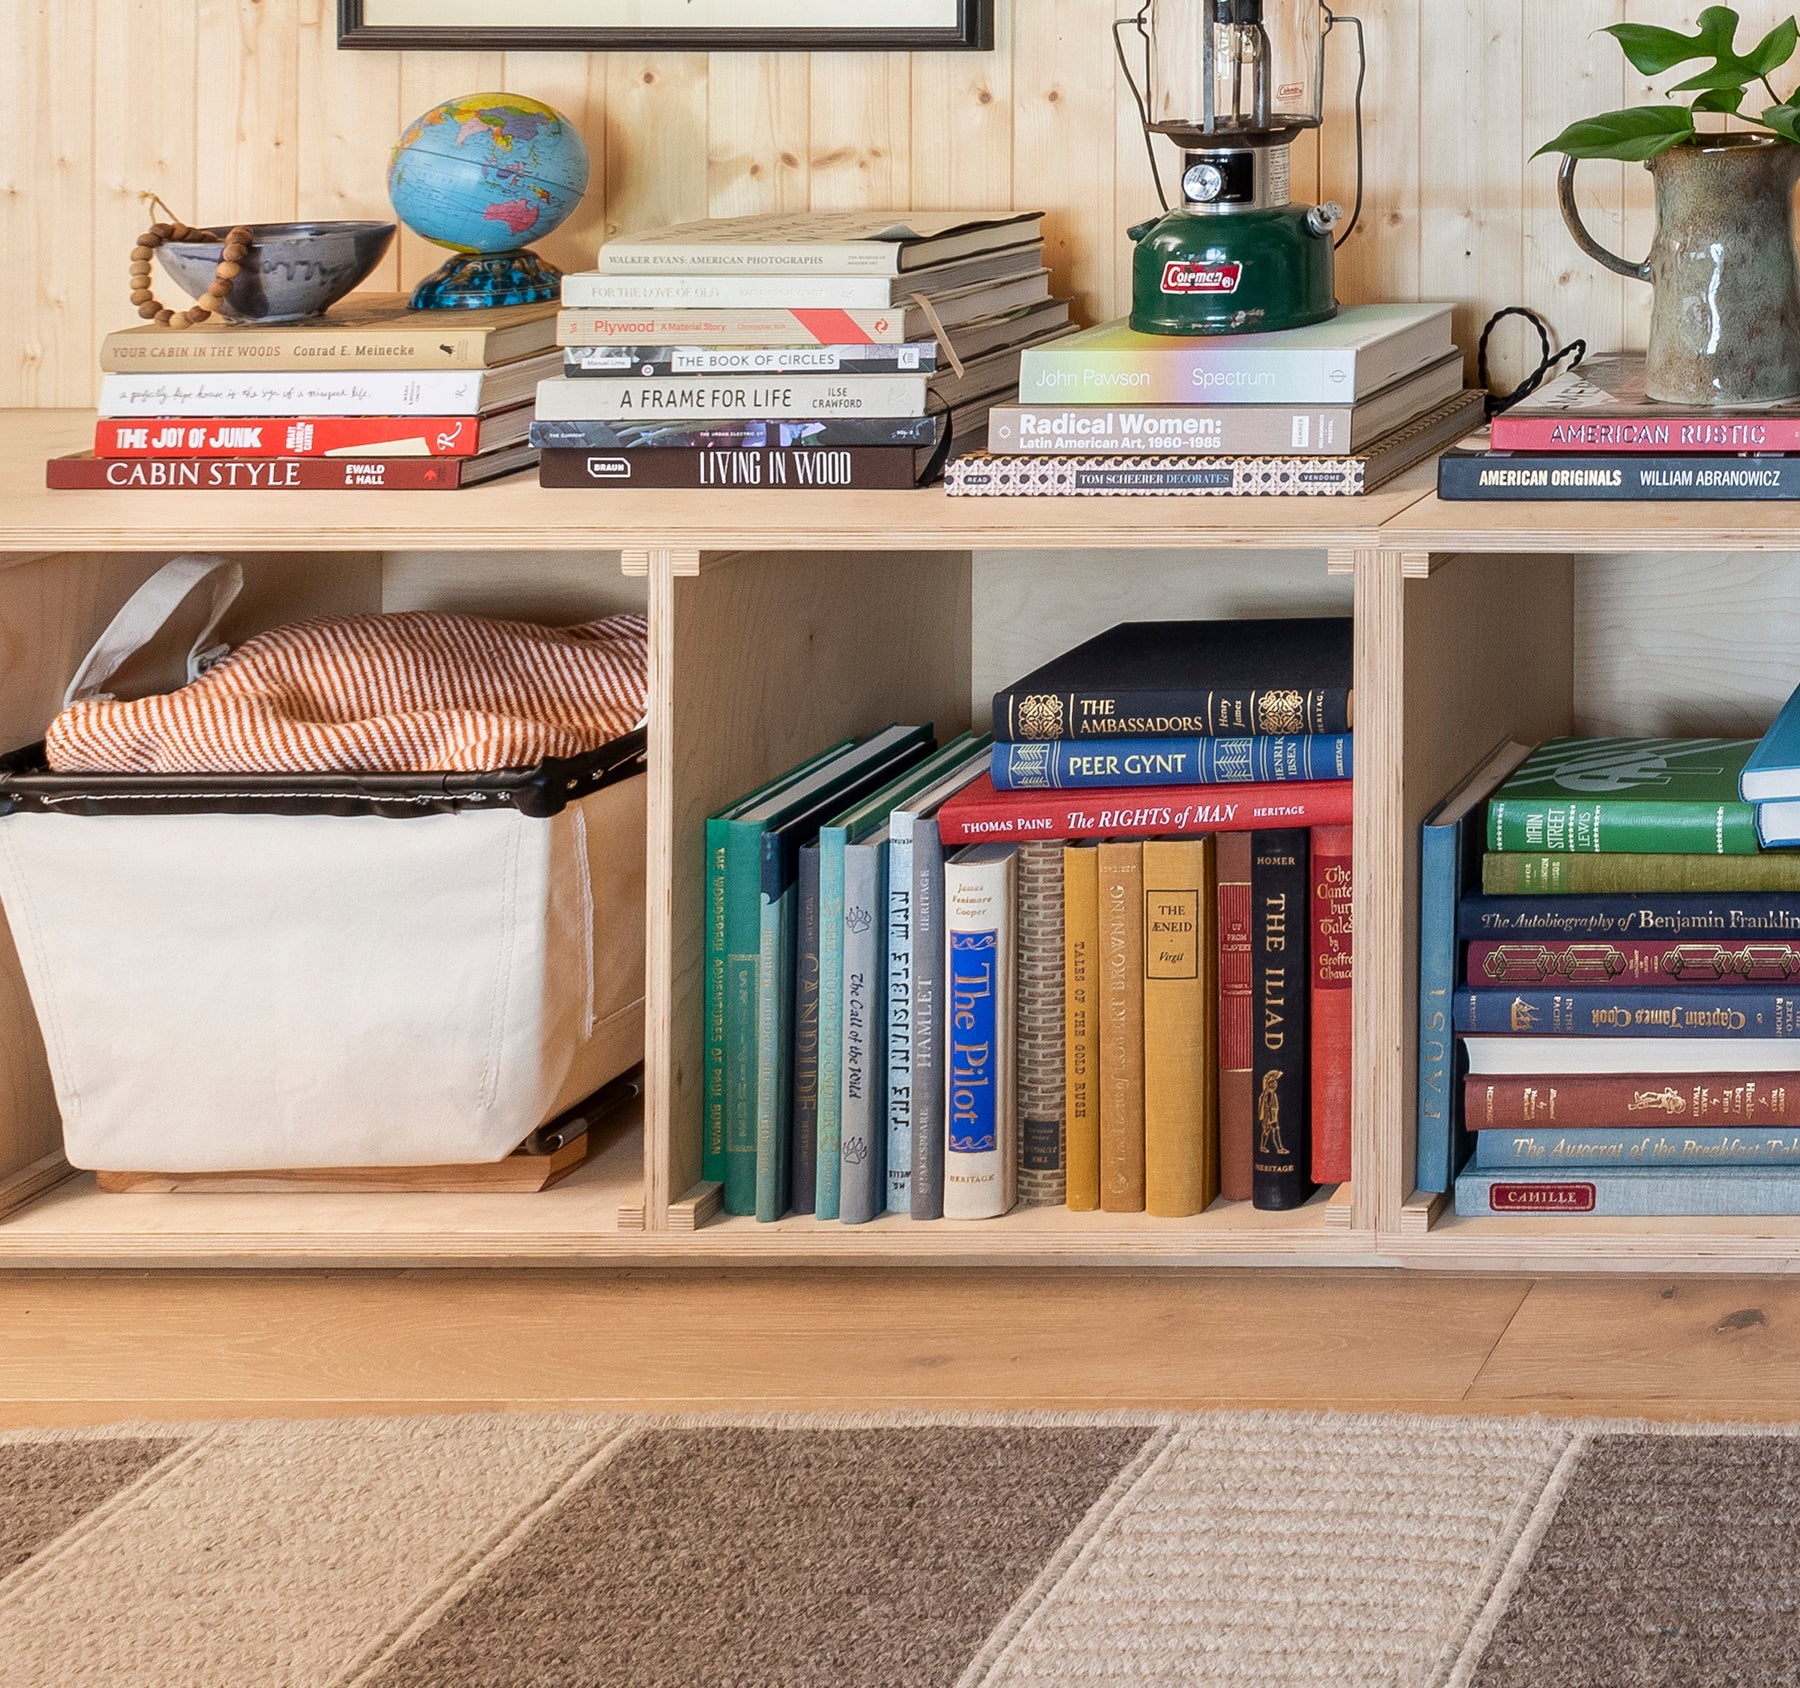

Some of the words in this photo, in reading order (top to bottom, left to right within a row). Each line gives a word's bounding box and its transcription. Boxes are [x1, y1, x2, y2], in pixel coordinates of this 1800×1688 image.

[112, 345, 147, 358] YOUR
[150, 345, 190, 358] CABIN
[193, 345, 207, 358] IN
[209, 345, 233, 358] THE
[236, 345, 281, 358] WOODS
[293, 344, 336, 357] Conrad
[340, 344, 352, 356] E.
[355, 343, 414, 357] Meinecke
[678, 356, 704, 367] THE
[709, 356, 749, 366] BOOK
[755, 355, 774, 366] OF
[778, 354, 834, 365] CIRCLES
[1035, 370, 1078, 387] John
[1082, 370, 1150, 386] Pawson
[1191, 369, 1275, 389] Spectrum
[620, 390, 632, 408] A
[641, 389, 705, 408] FRAME
[711, 390, 746, 407] FOR
[754, 389, 792, 407] LIFE
[1020, 414, 1113, 435] Radical
[1120, 414, 1222, 435] Women:
[106, 461, 200, 486] CABIN
[209, 462, 301, 486] STYLE
[345, 465, 385, 475] EWALD
[700, 452, 762, 484] LIVING
[769, 451, 786, 484] IN
[792, 452, 851, 484] WOOD
[345, 475, 354, 484] &
[356, 475, 385, 484] HALL
[1479, 470, 1549, 486] AMERICAN
[1550, 470, 1622, 486] ORIGINALS
[1640, 471, 1693, 486] WILLIAM
[1695, 470, 1781, 486] ABRANOWICZ
[1080, 700, 1115, 715] THE
[1080, 716, 1202, 733] AMBASSADORS
[1069, 755, 1120, 776] PEER
[1124, 754, 1186, 774] GYNT
[1067, 812, 1095, 830] The
[1099, 808, 1170, 828] RIGHTS
[1174, 809, 1190, 829] of
[1193, 804, 1238, 823] MAN
[1256, 857, 1295, 866] HOMER
[1266, 893, 1286, 951] THE
[1481, 914, 1510, 929] The
[1511, 913, 1614, 932] Autobiography
[1618, 913, 1636, 930] of
[1639, 911, 1725, 934] Benjamin
[1729, 910, 1800, 929] Franklin
[954, 962, 990, 1030] The
[1265, 968, 1285, 1051] ILIAD
[953, 1042, 990, 1124] Pilot
[1507, 1191, 1576, 1204] CAMILLE
